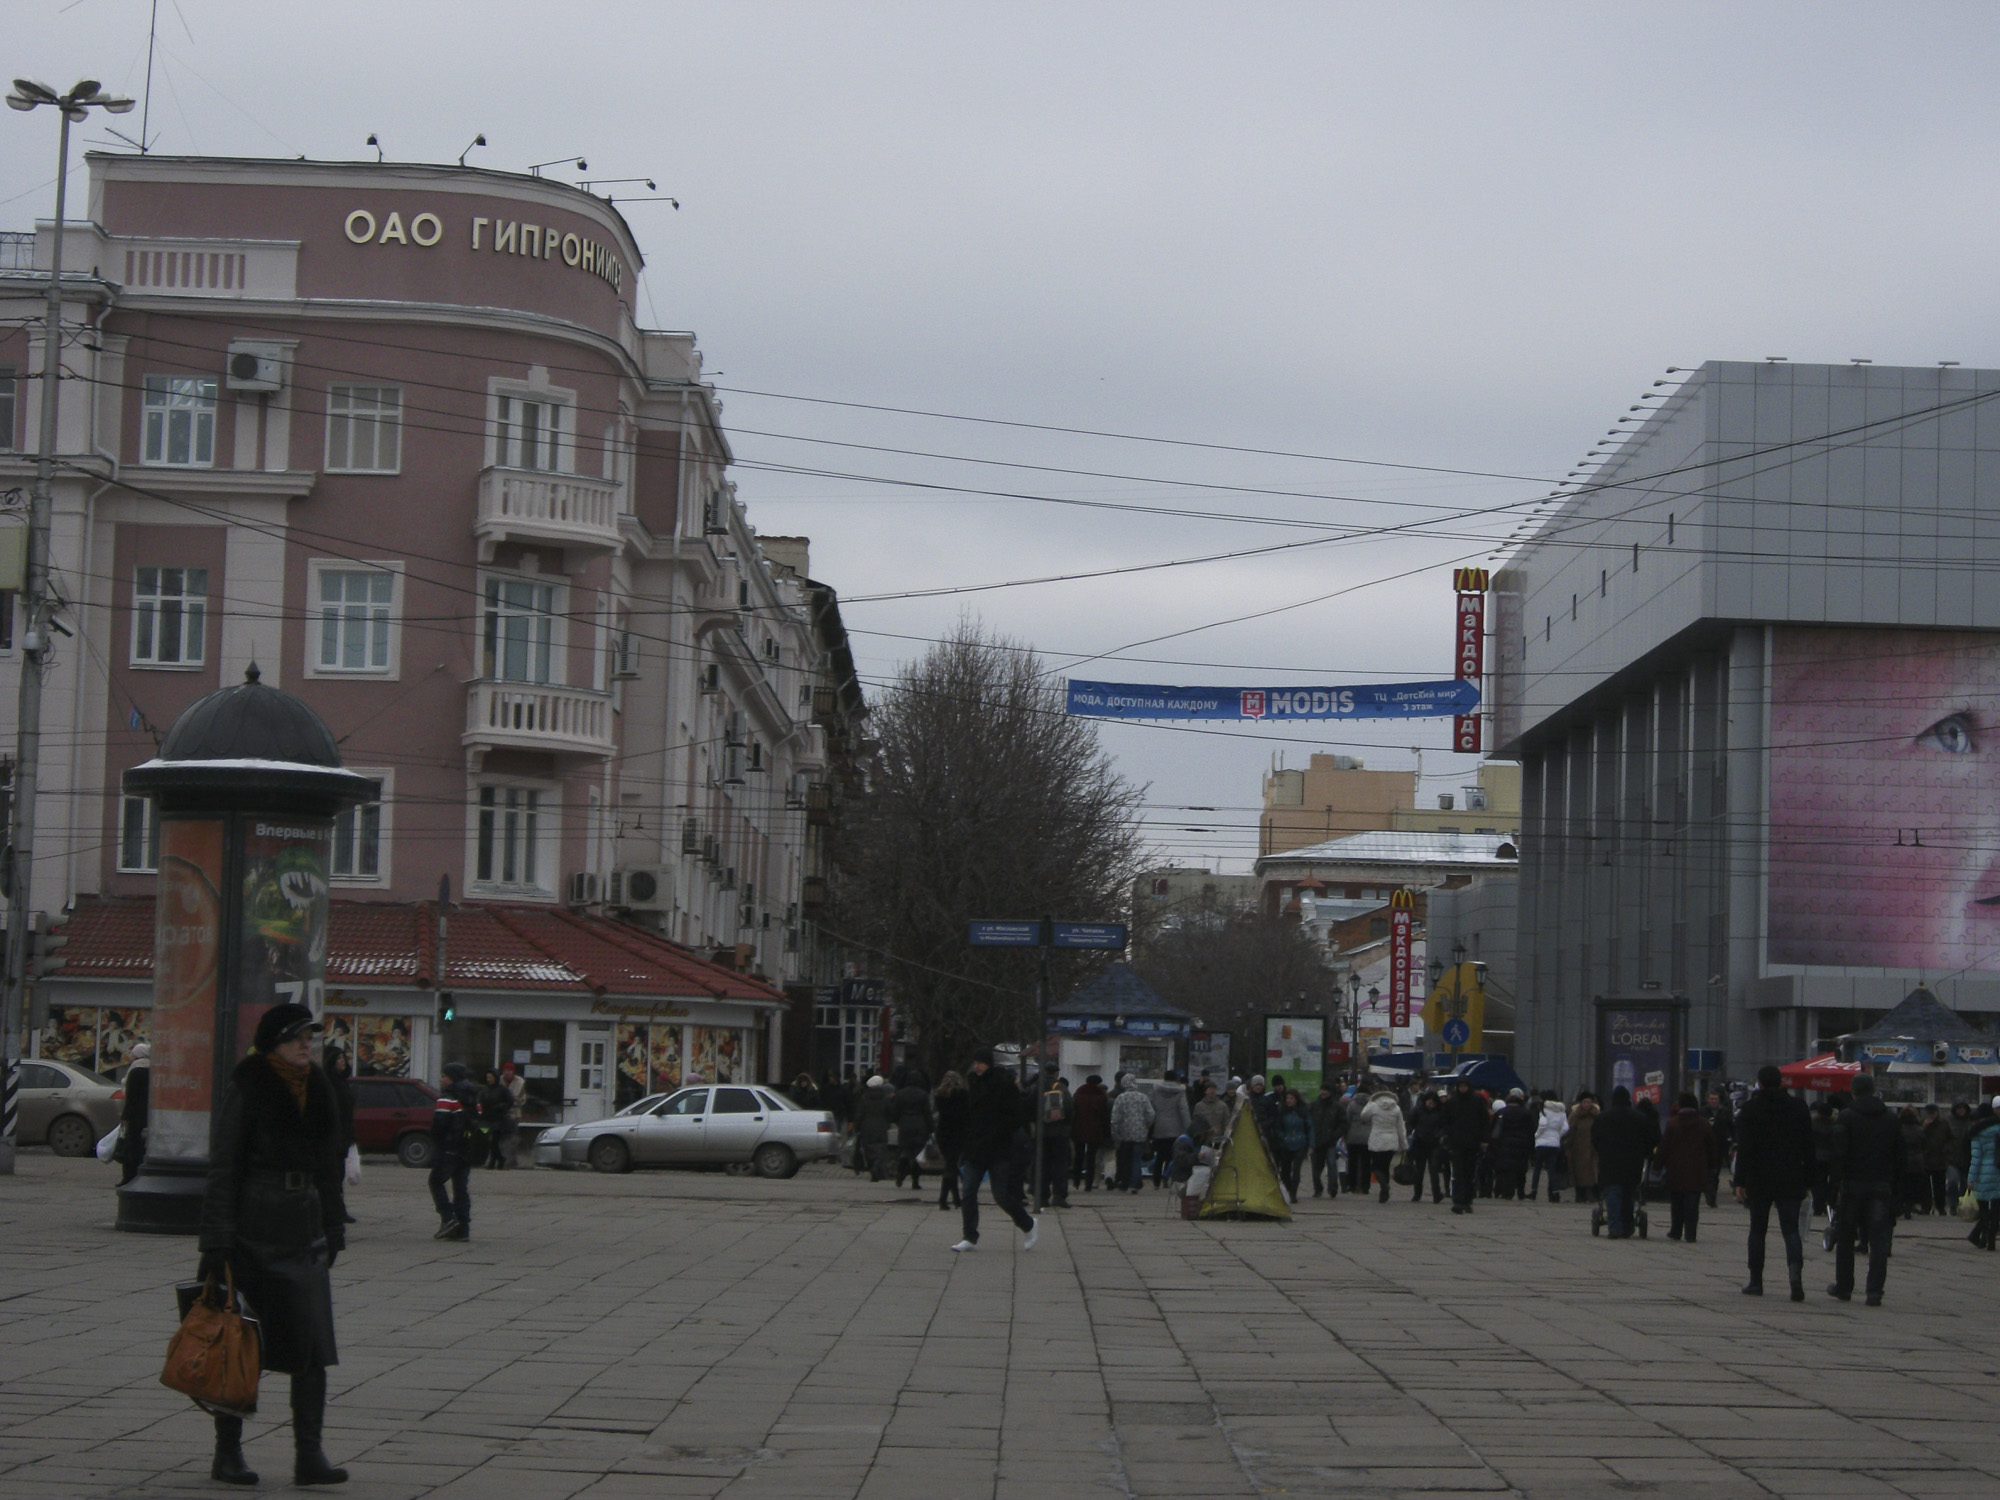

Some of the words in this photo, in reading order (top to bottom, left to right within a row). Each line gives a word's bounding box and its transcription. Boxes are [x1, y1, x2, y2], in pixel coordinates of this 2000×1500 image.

[344, 210, 443, 247] ОАО
[472, 217, 621, 295] ГИПРОНИИГАЗ
[1106, 697, 1164, 709] ДОСТУПНАЯ
[1167, 700, 1218, 711] КАЖДОМУ
[1271, 691, 1355, 714] MODIS
[1374, 693, 1388, 702] ТЦ
[1403, 703, 1409, 711] 3
[1411, 703, 1434, 711] этаж
[255, 823, 317, 841] Впервые
[1394, 912, 1410, 1025] Макдоналдс
